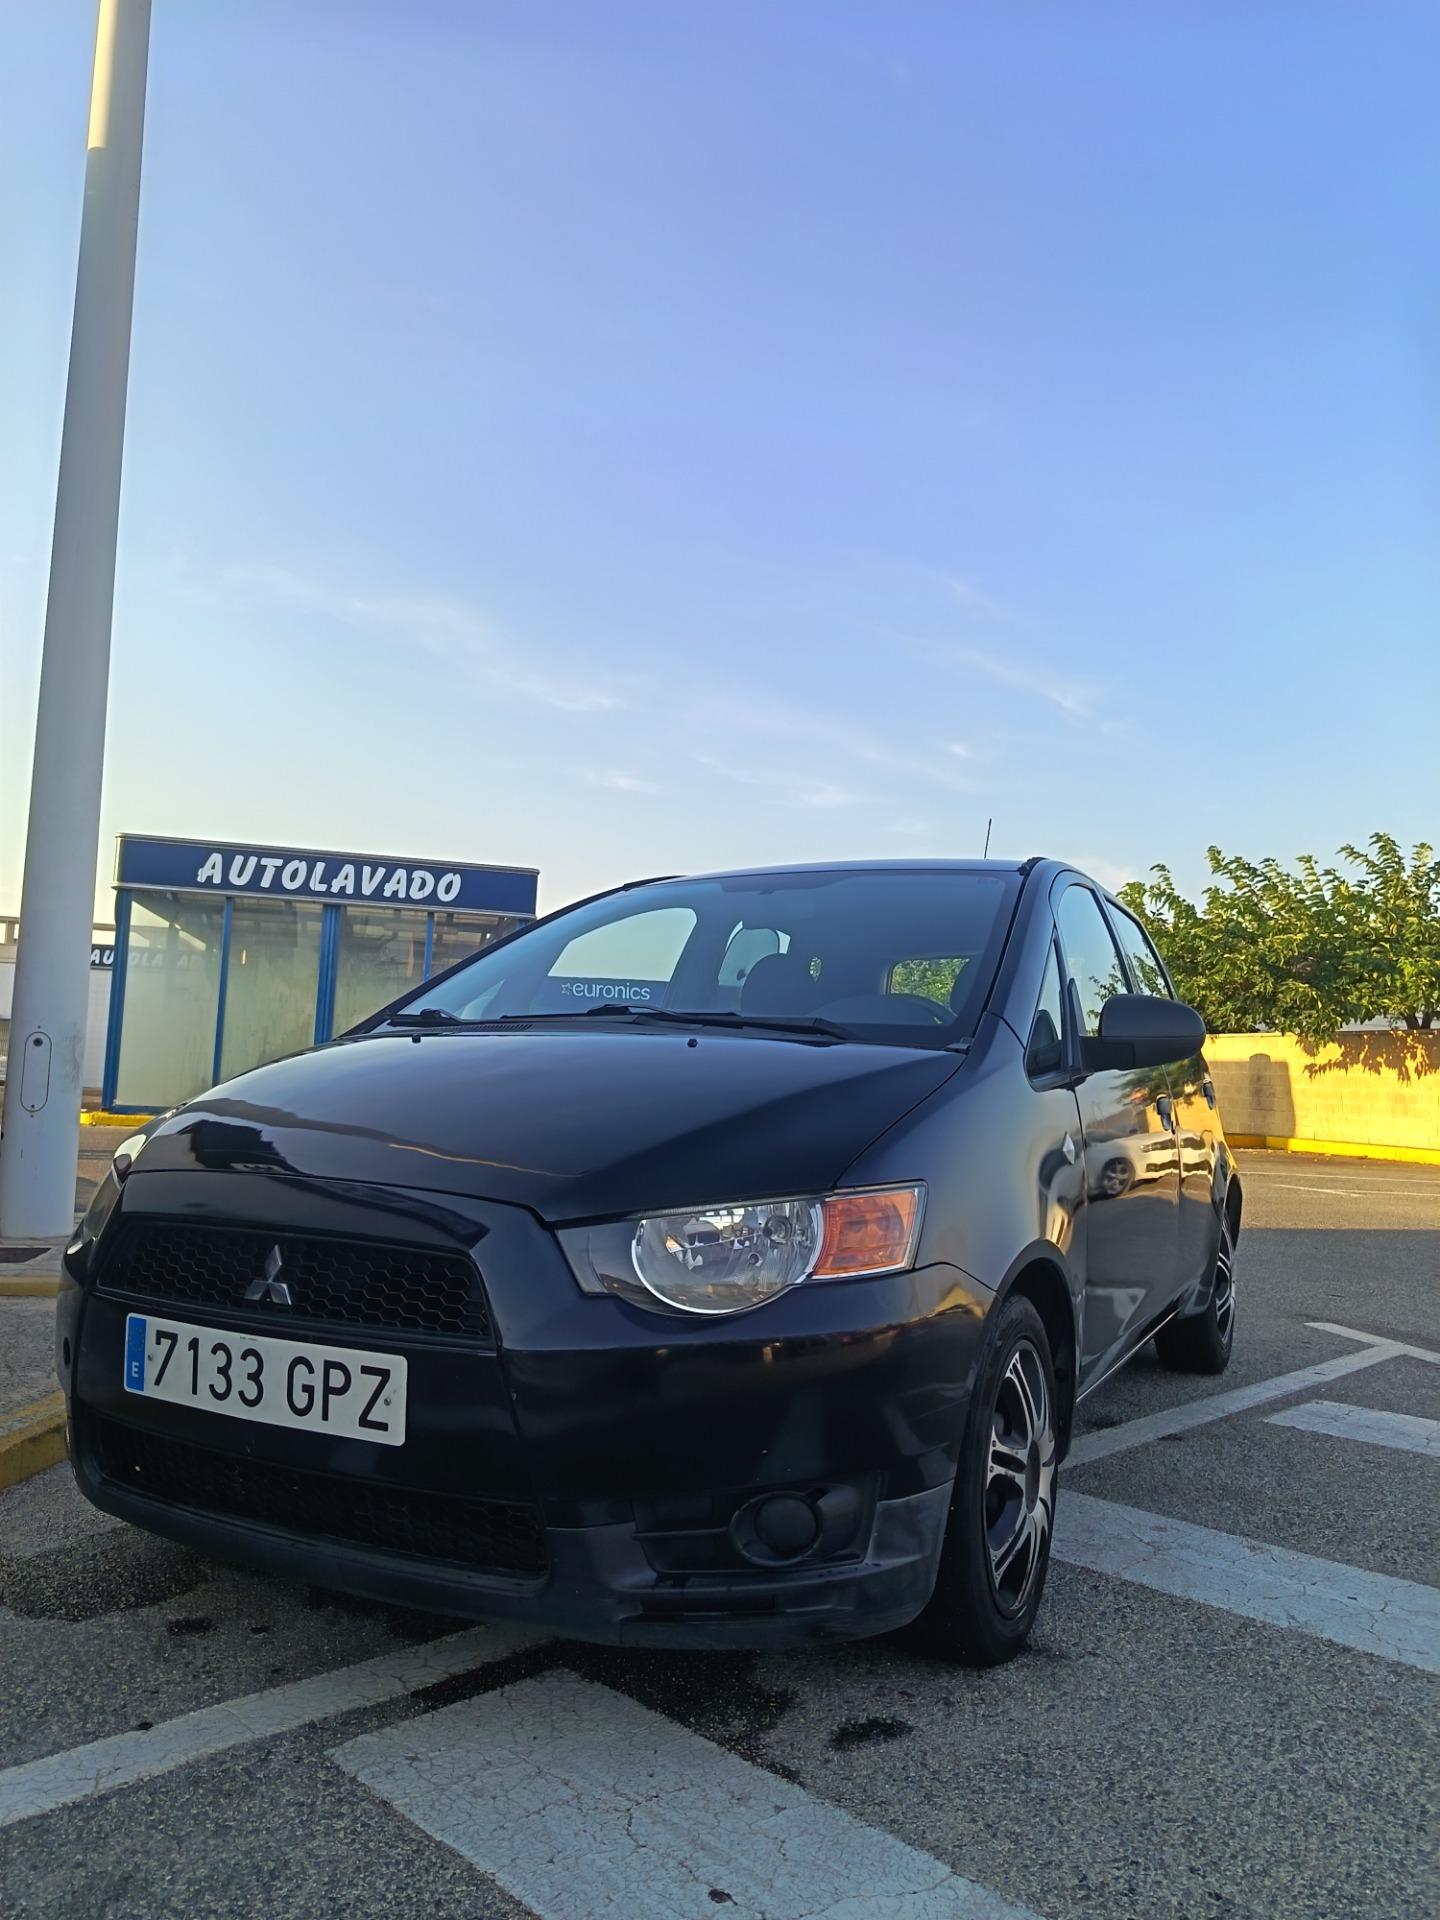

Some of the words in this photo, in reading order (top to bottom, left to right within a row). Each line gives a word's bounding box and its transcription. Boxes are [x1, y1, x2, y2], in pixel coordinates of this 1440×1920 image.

[197, 852, 462, 902] AUTOLAVADO
[572, 982, 651, 1000] euronics
[131, 1361, 139, 1378] E
[153, 1329, 264, 1408] 7133
[286, 1355, 392, 1432] GPZ
